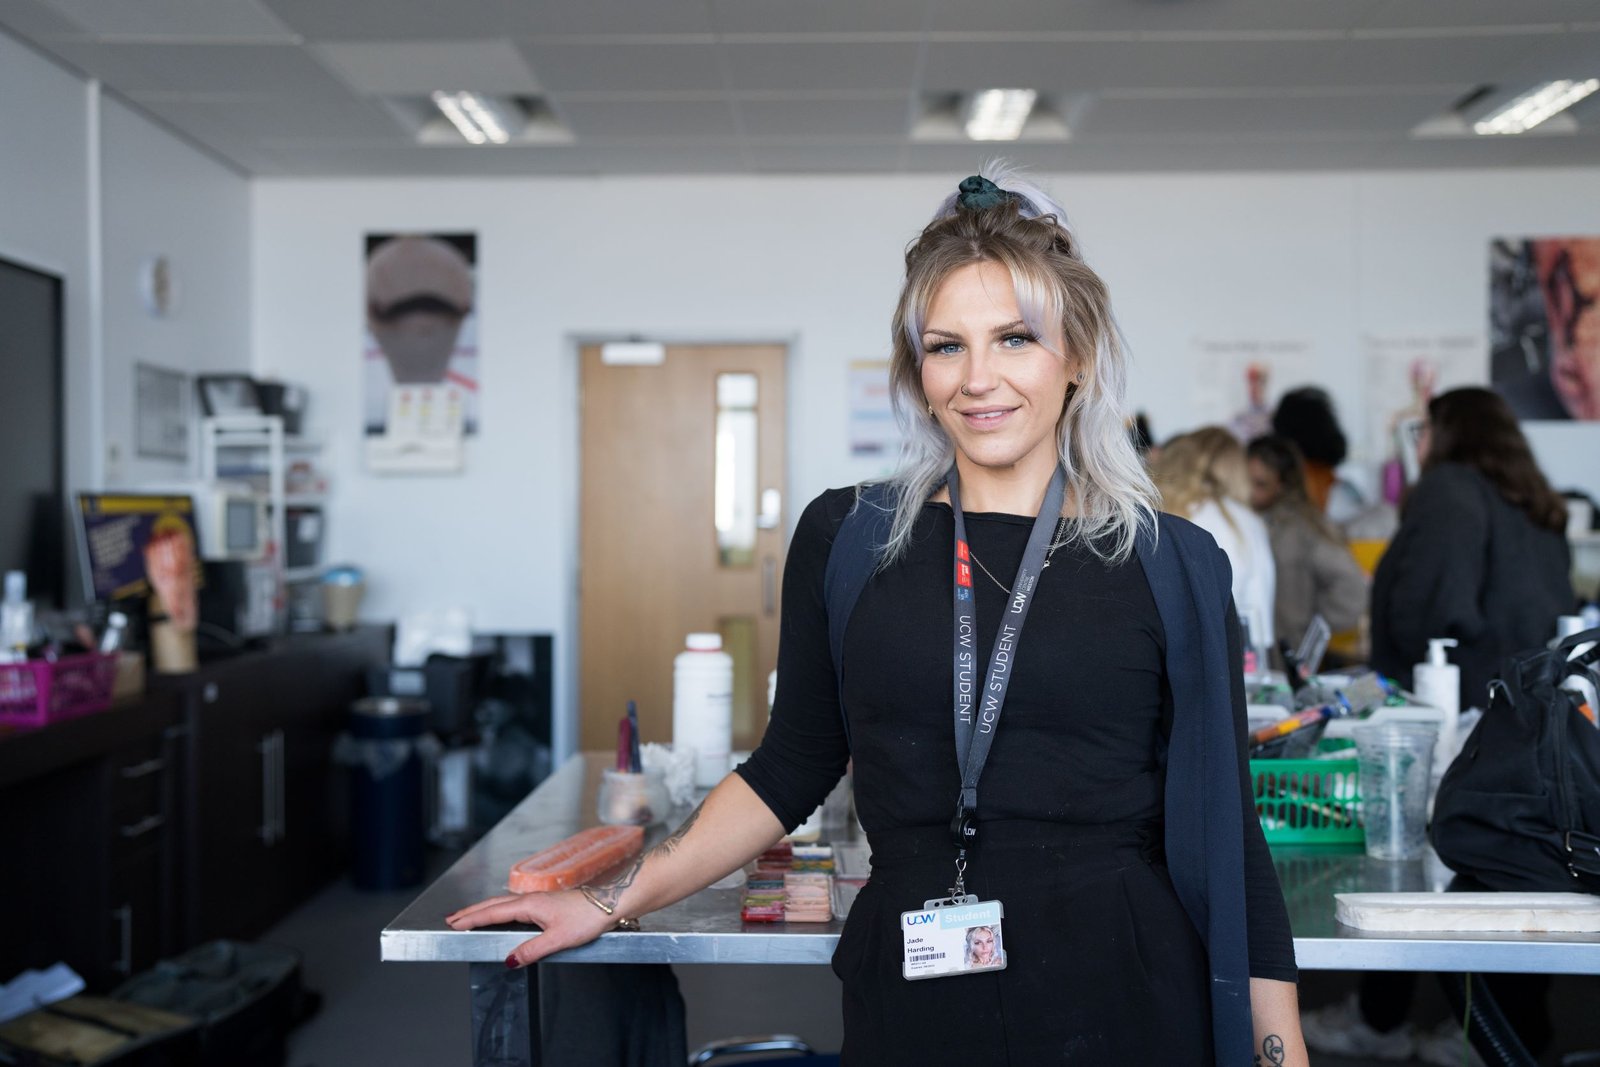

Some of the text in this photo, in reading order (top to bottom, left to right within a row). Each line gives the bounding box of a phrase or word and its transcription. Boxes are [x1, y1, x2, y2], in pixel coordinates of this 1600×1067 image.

[1010, 592, 1027, 614] UCW
[959, 615, 972, 648] UCW
[979, 624, 1017, 734] UCW STUDENT
[959, 652, 972, 725] STUDENT
[906, 913, 936, 926] UCW
[945, 909, 993, 923] Student
[907, 937, 924, 945] Jade
[907, 945, 935, 954] Harding
